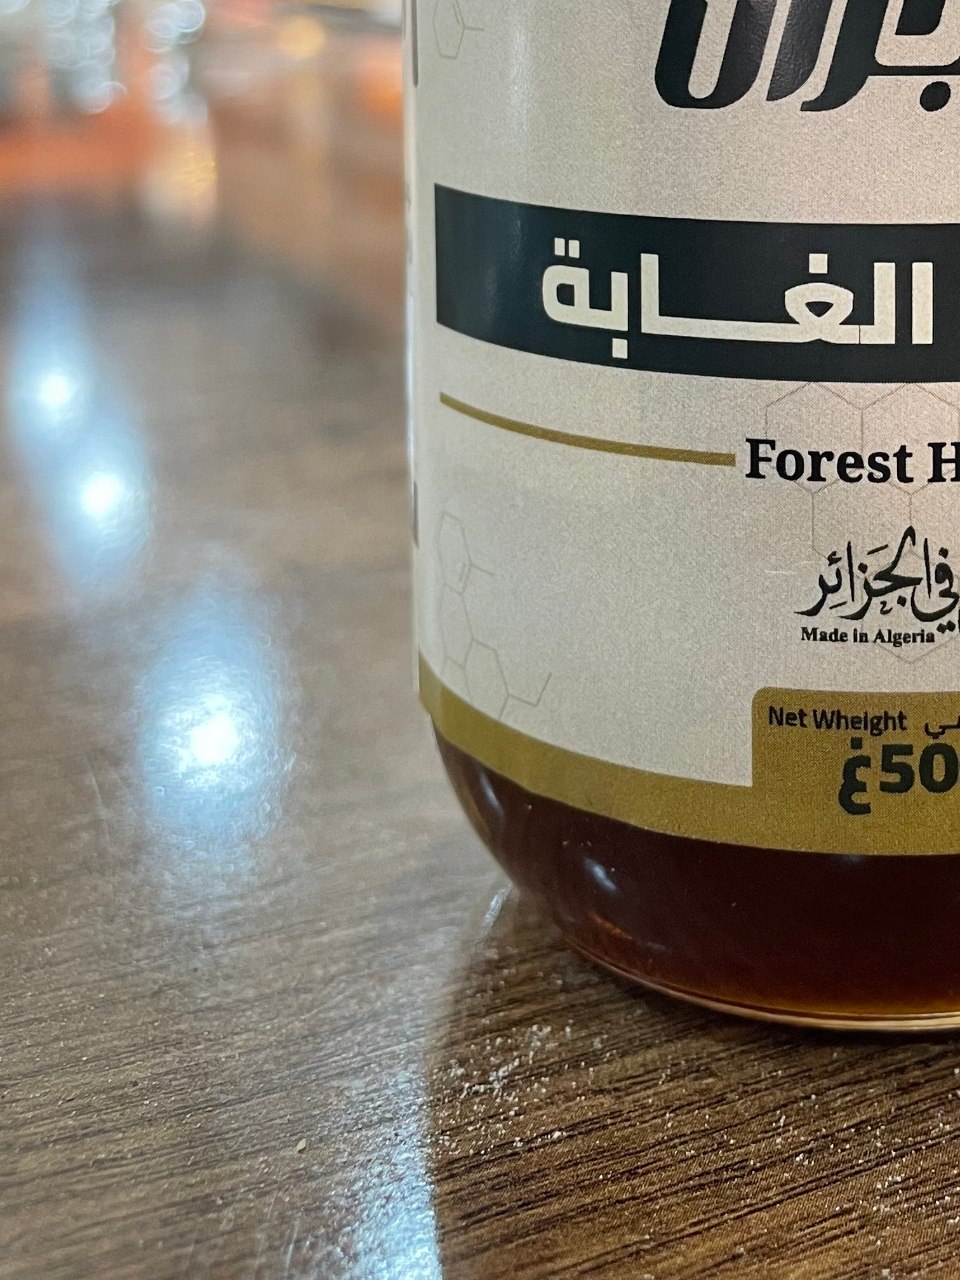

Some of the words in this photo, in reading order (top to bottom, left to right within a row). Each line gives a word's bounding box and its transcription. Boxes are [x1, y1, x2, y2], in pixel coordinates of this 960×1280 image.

[541, 236, 934, 360] الغابة
[745, 437, 914, 484] Forest
[801, 626, 848, 643] Made
[852, 628, 869, 643] in
[873, 629, 936, 647] Algeria
[768, 705, 808, 728] Net
[812, 708, 908, 737] Wheight
